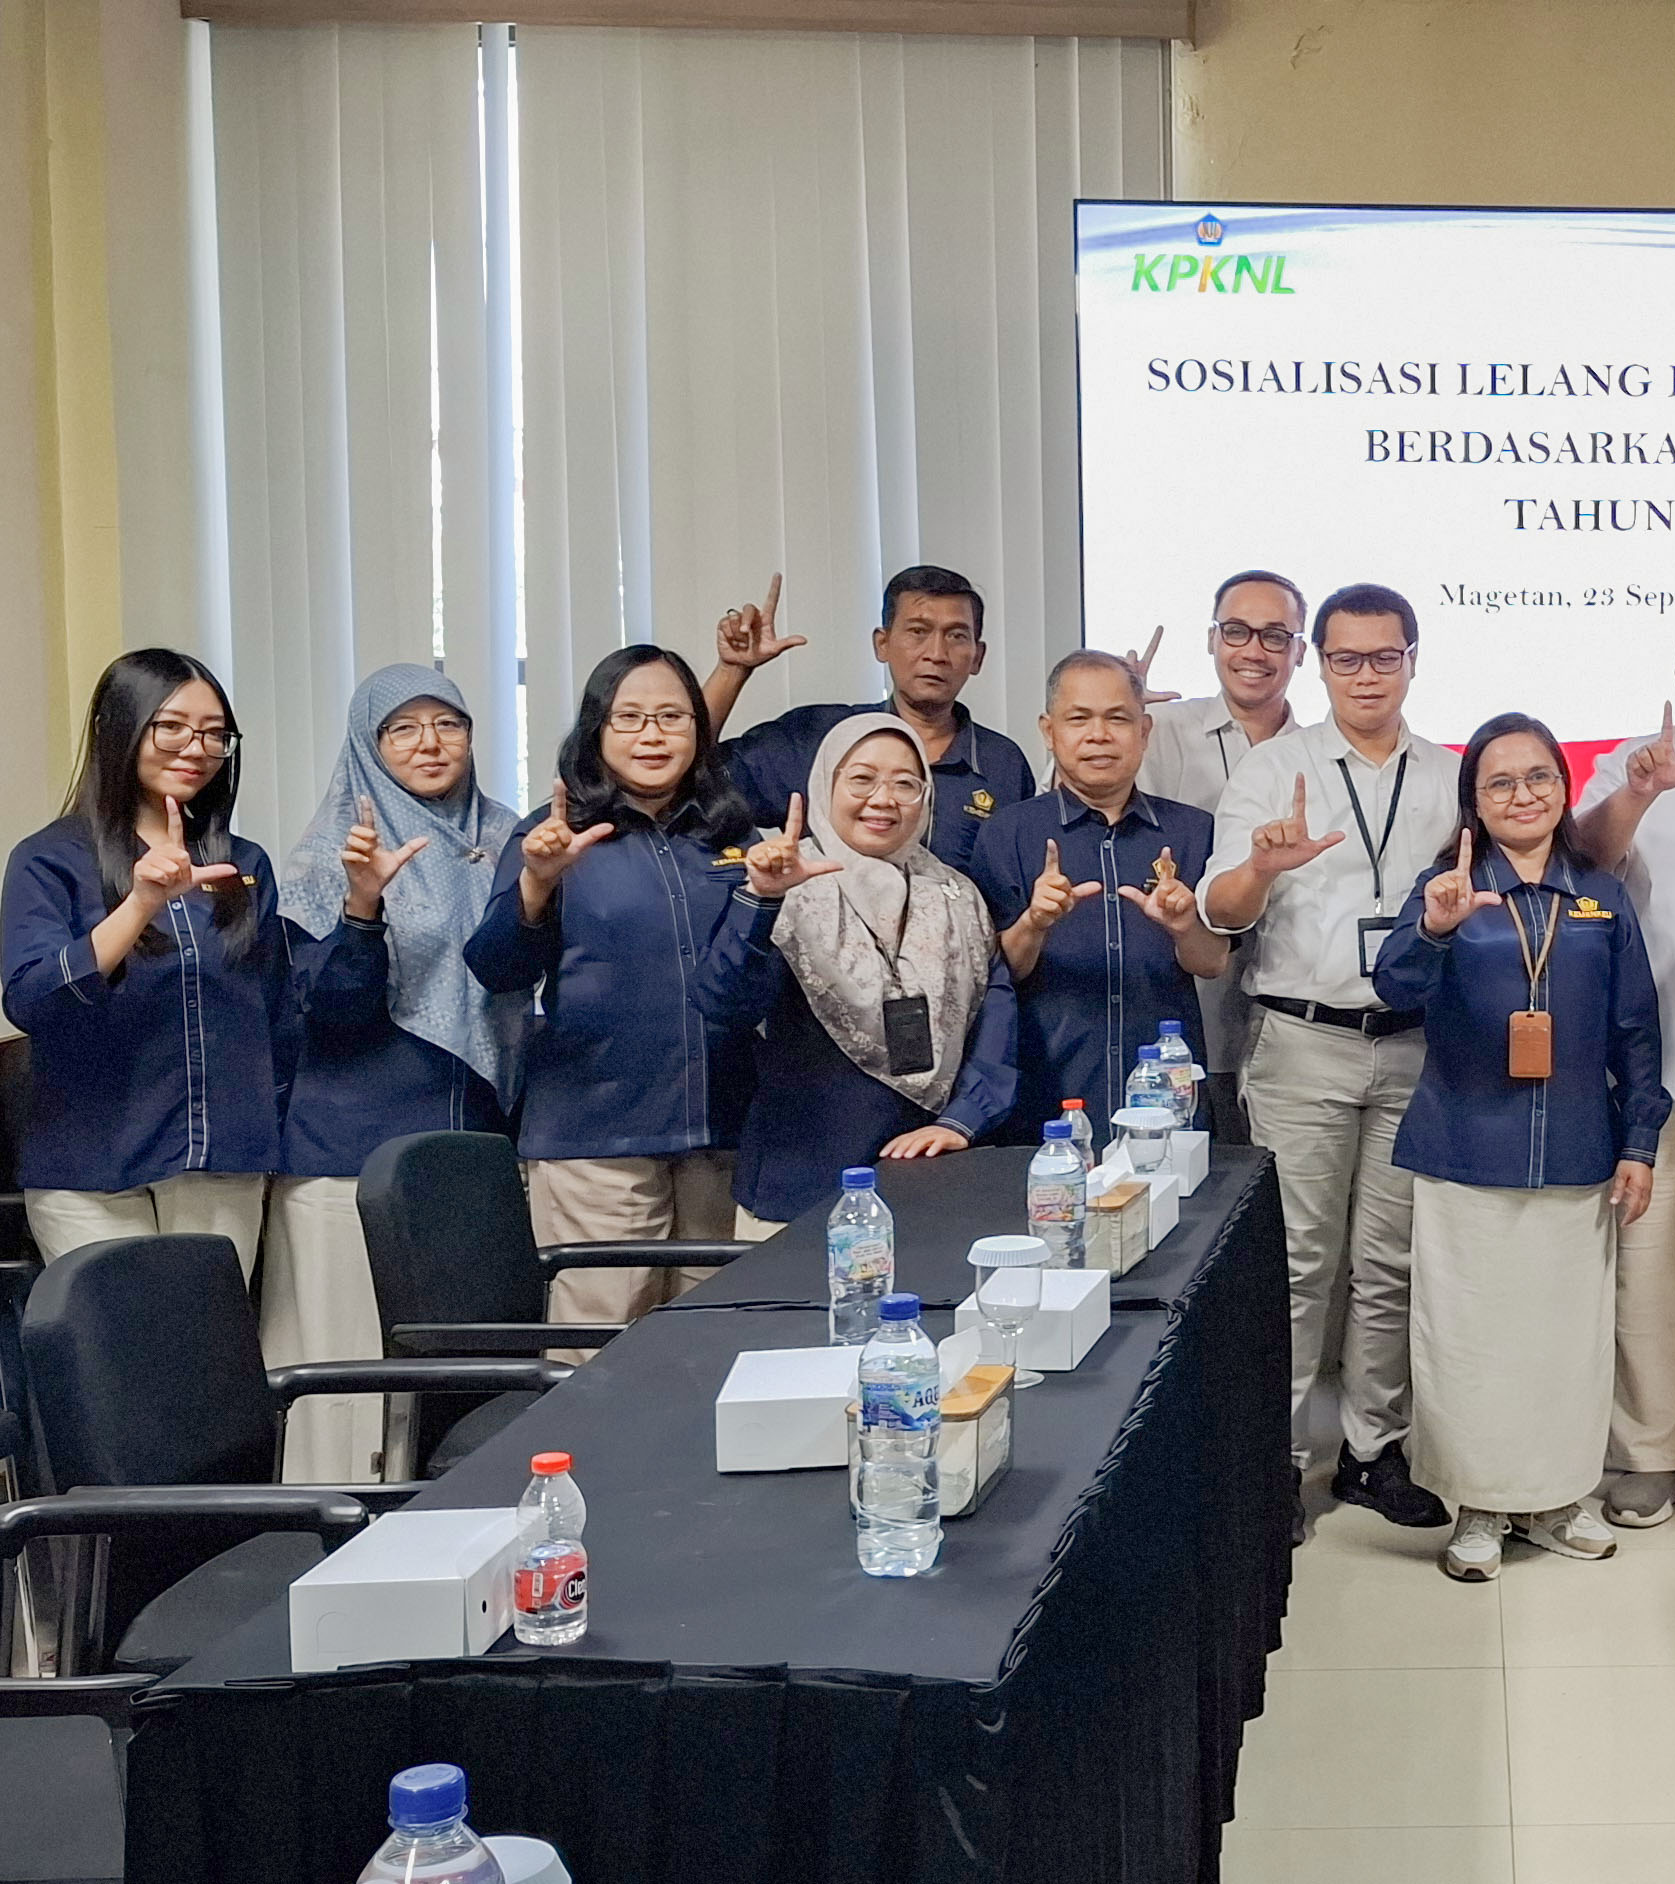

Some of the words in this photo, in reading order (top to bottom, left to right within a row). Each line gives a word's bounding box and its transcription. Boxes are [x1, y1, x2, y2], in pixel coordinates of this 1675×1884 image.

[1131, 254, 1296, 294] KPKNL
[1147, 358, 1439, 395] SOSIALISASI
[1457, 363, 1652, 397] LELANG
[1503, 498, 1674, 532] TAHUN
[1439, 584, 1571, 614] Magetan,
[1583, 588, 1615, 607] 23
